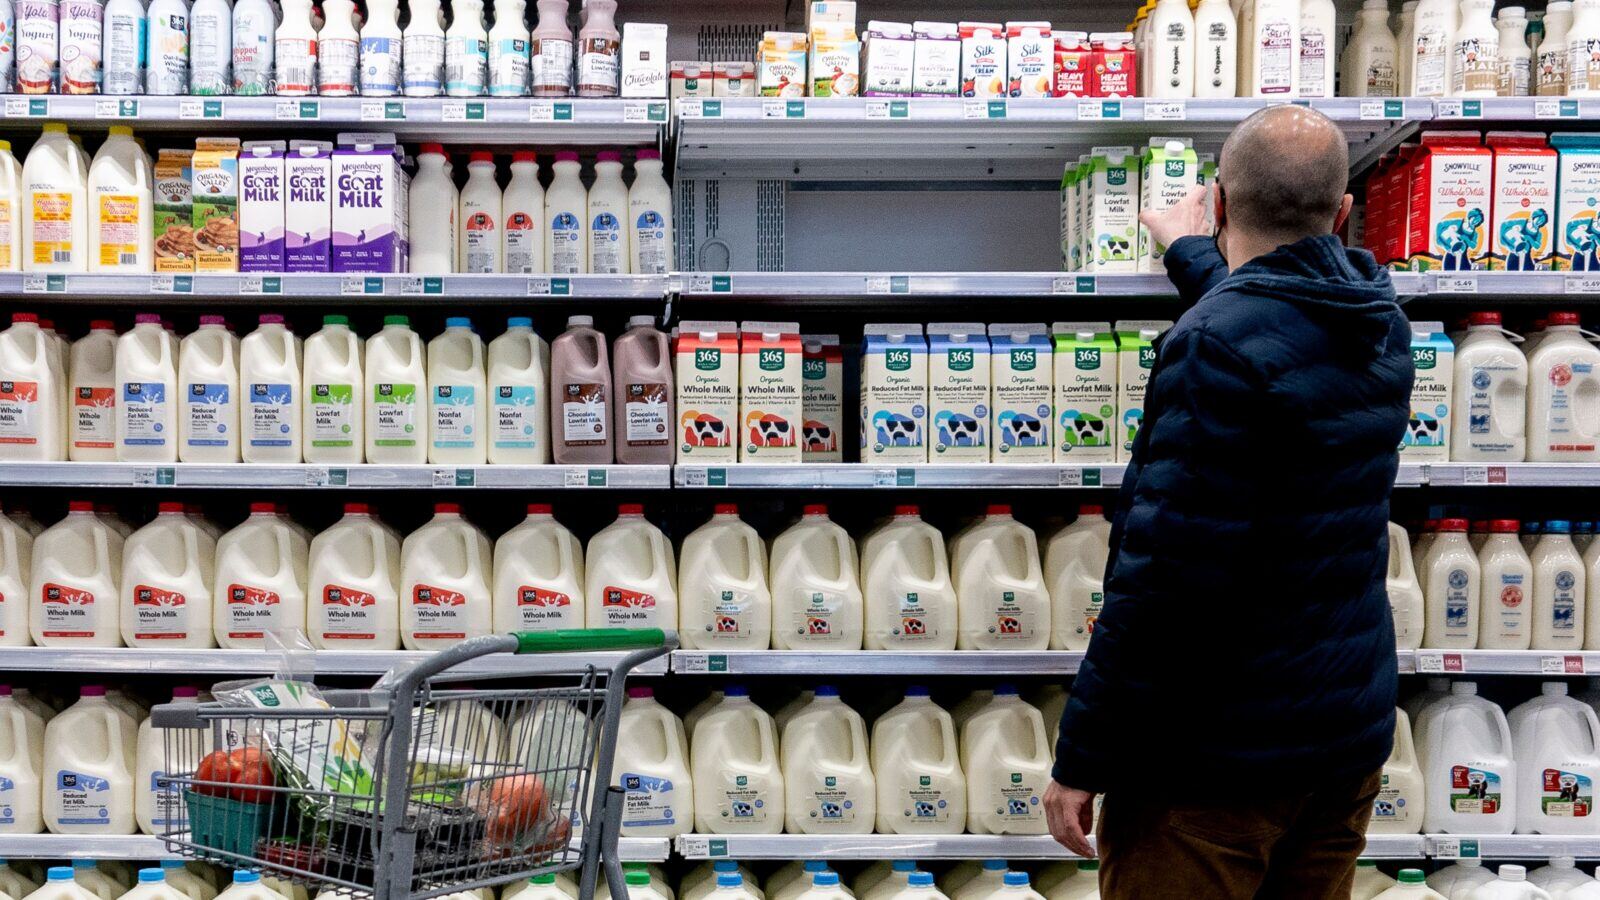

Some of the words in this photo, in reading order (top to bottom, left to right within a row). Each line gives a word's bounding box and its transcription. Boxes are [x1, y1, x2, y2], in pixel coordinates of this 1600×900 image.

[22, 28, 54, 40] Yogurt
[974, 45, 994, 58] Silk
[1020, 44, 1042, 58] Silk
[624, 72, 665, 86] Chocolate
[1101, 74, 1127, 82] HEAVY
[246, 164, 278, 175] Meyenberg
[292, 164, 324, 175] Meyenberg
[342, 161, 382, 174] Meyenberg
[1167, 162, 1183, 171] 365
[1444, 163, 1480, 172] SNOWVILLE
[1508, 163, 1545, 172] SNOWVILLE
[197, 172, 231, 182] ORGANIC
[1109, 170, 1124, 179] 365
[159, 182, 191, 191] ORGANIC
[244, 176, 279, 188] Goat
[290, 176, 325, 188] Goat
[338, 174, 383, 190] Goat
[162, 188, 188, 196] VALLEY
[244, 189, 279, 202] Milk
[290, 189, 325, 202] Milk
[1106, 190, 1127, 198] Organic
[1438, 187, 1465, 196] Whole
[1466, 187, 1485, 196] Milk
[1502, 187, 1530, 196] Whole
[1531, 187, 1549, 196] Milk
[339, 192, 382, 208] Milk
[698, 350, 718, 362] 365
[762, 350, 782, 362] 365
[888, 351, 909, 363] 365
[950, 351, 971, 363] 365
[1013, 352, 1034, 363] 365
[1077, 350, 1098, 362] 365
[1413, 350, 1434, 361] 365
[804, 362, 824, 372] 365
[696, 376, 719, 384] Organic
[760, 376, 783, 384] Organic
[886, 376, 910, 384] Organic
[948, 376, 972, 384] Organic
[1012, 376, 1035, 384] Organic
[1076, 375, 1100, 383] Organic
[1414, 375, 1435, 383] rganic
[256, 687, 274, 699] 365
